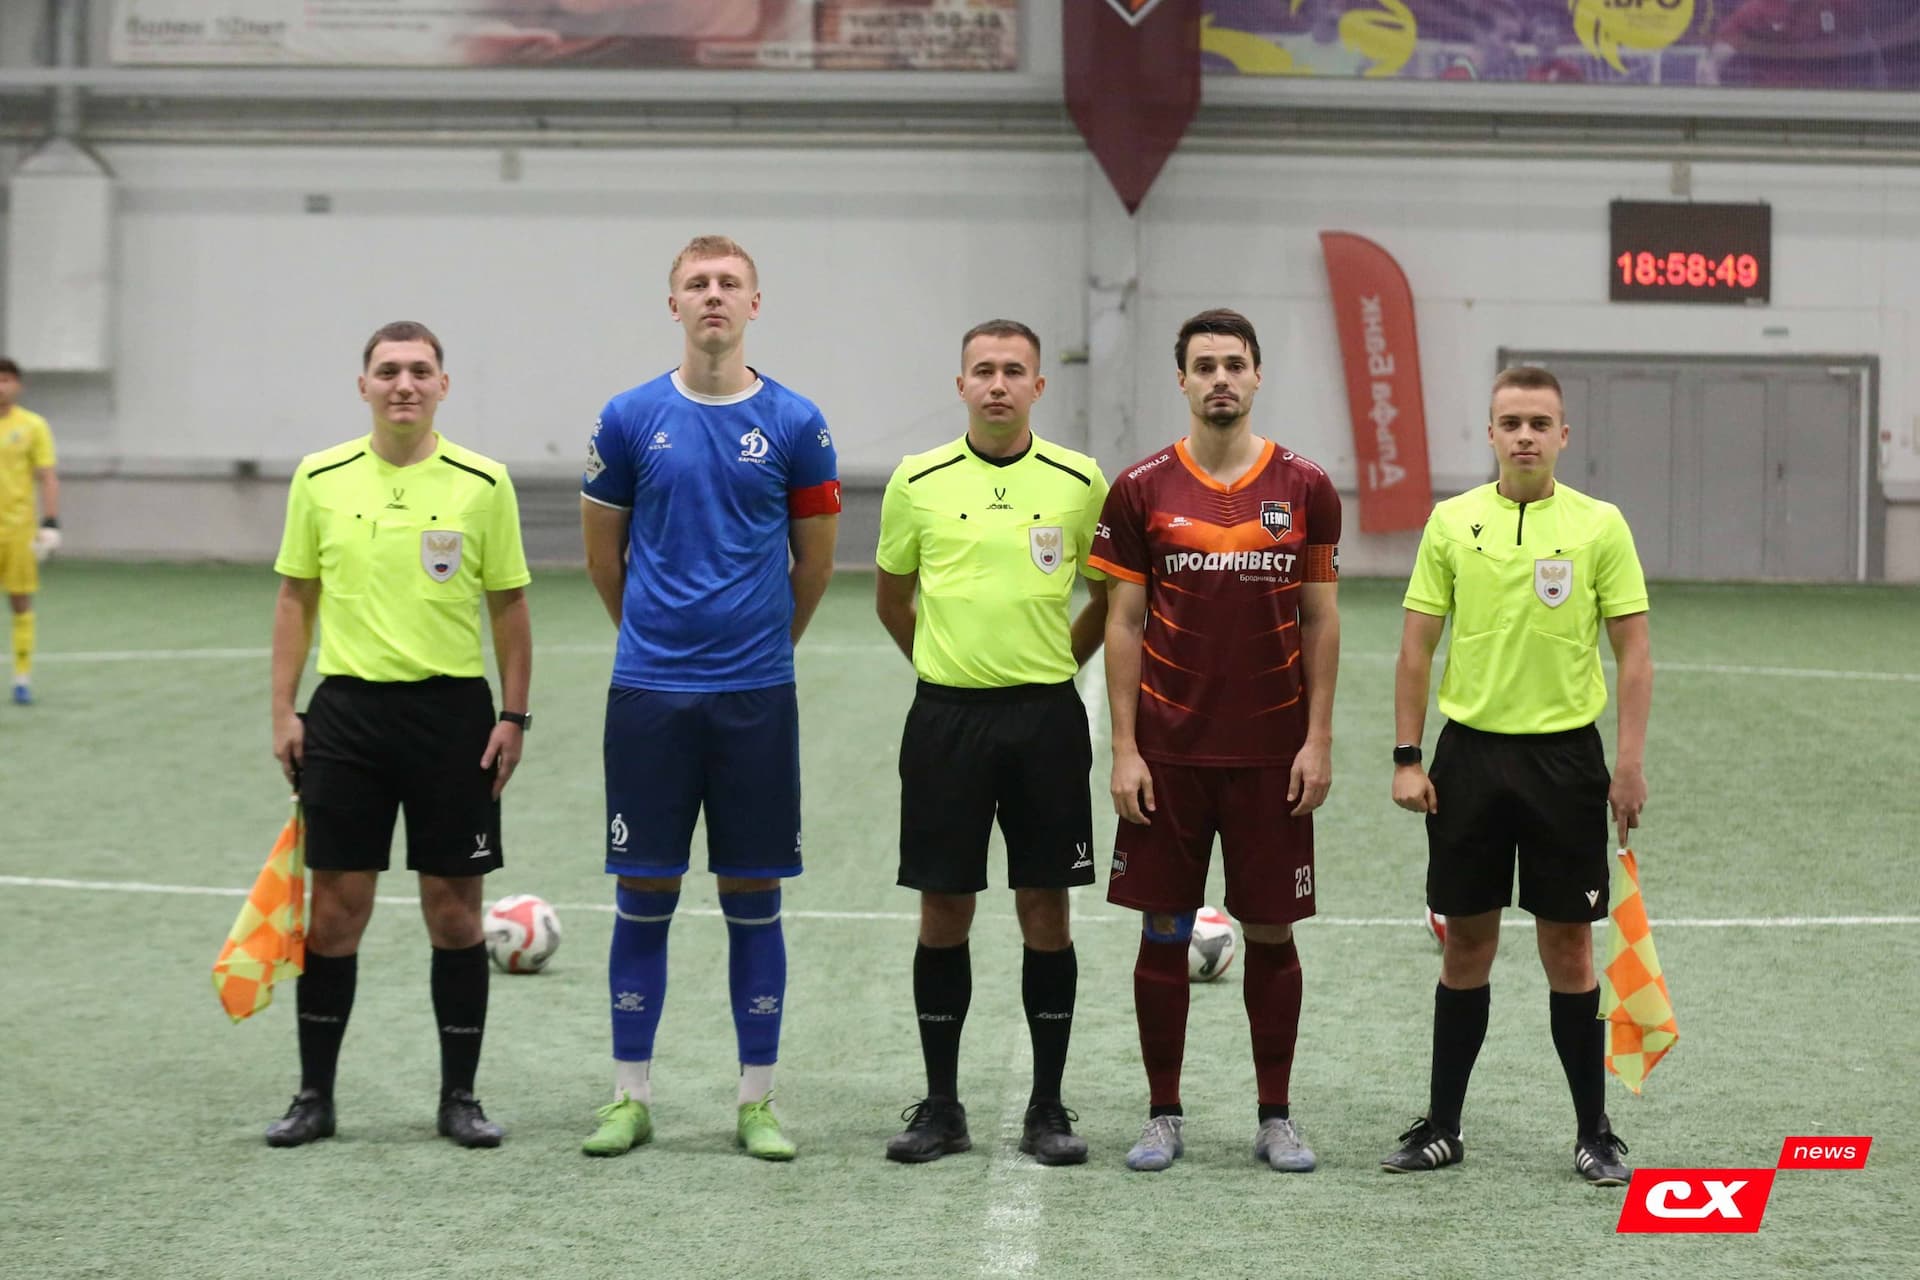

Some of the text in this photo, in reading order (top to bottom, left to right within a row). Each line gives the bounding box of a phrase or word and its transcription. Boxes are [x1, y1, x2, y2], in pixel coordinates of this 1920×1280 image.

[1617, 251, 1758, 288] 18:58:49
[1263, 511, 1290, 528] ТЕМП
[1165, 551, 1297, 575] ПРОДИНВЕСТ
[1295, 864, 1312, 899] 23
